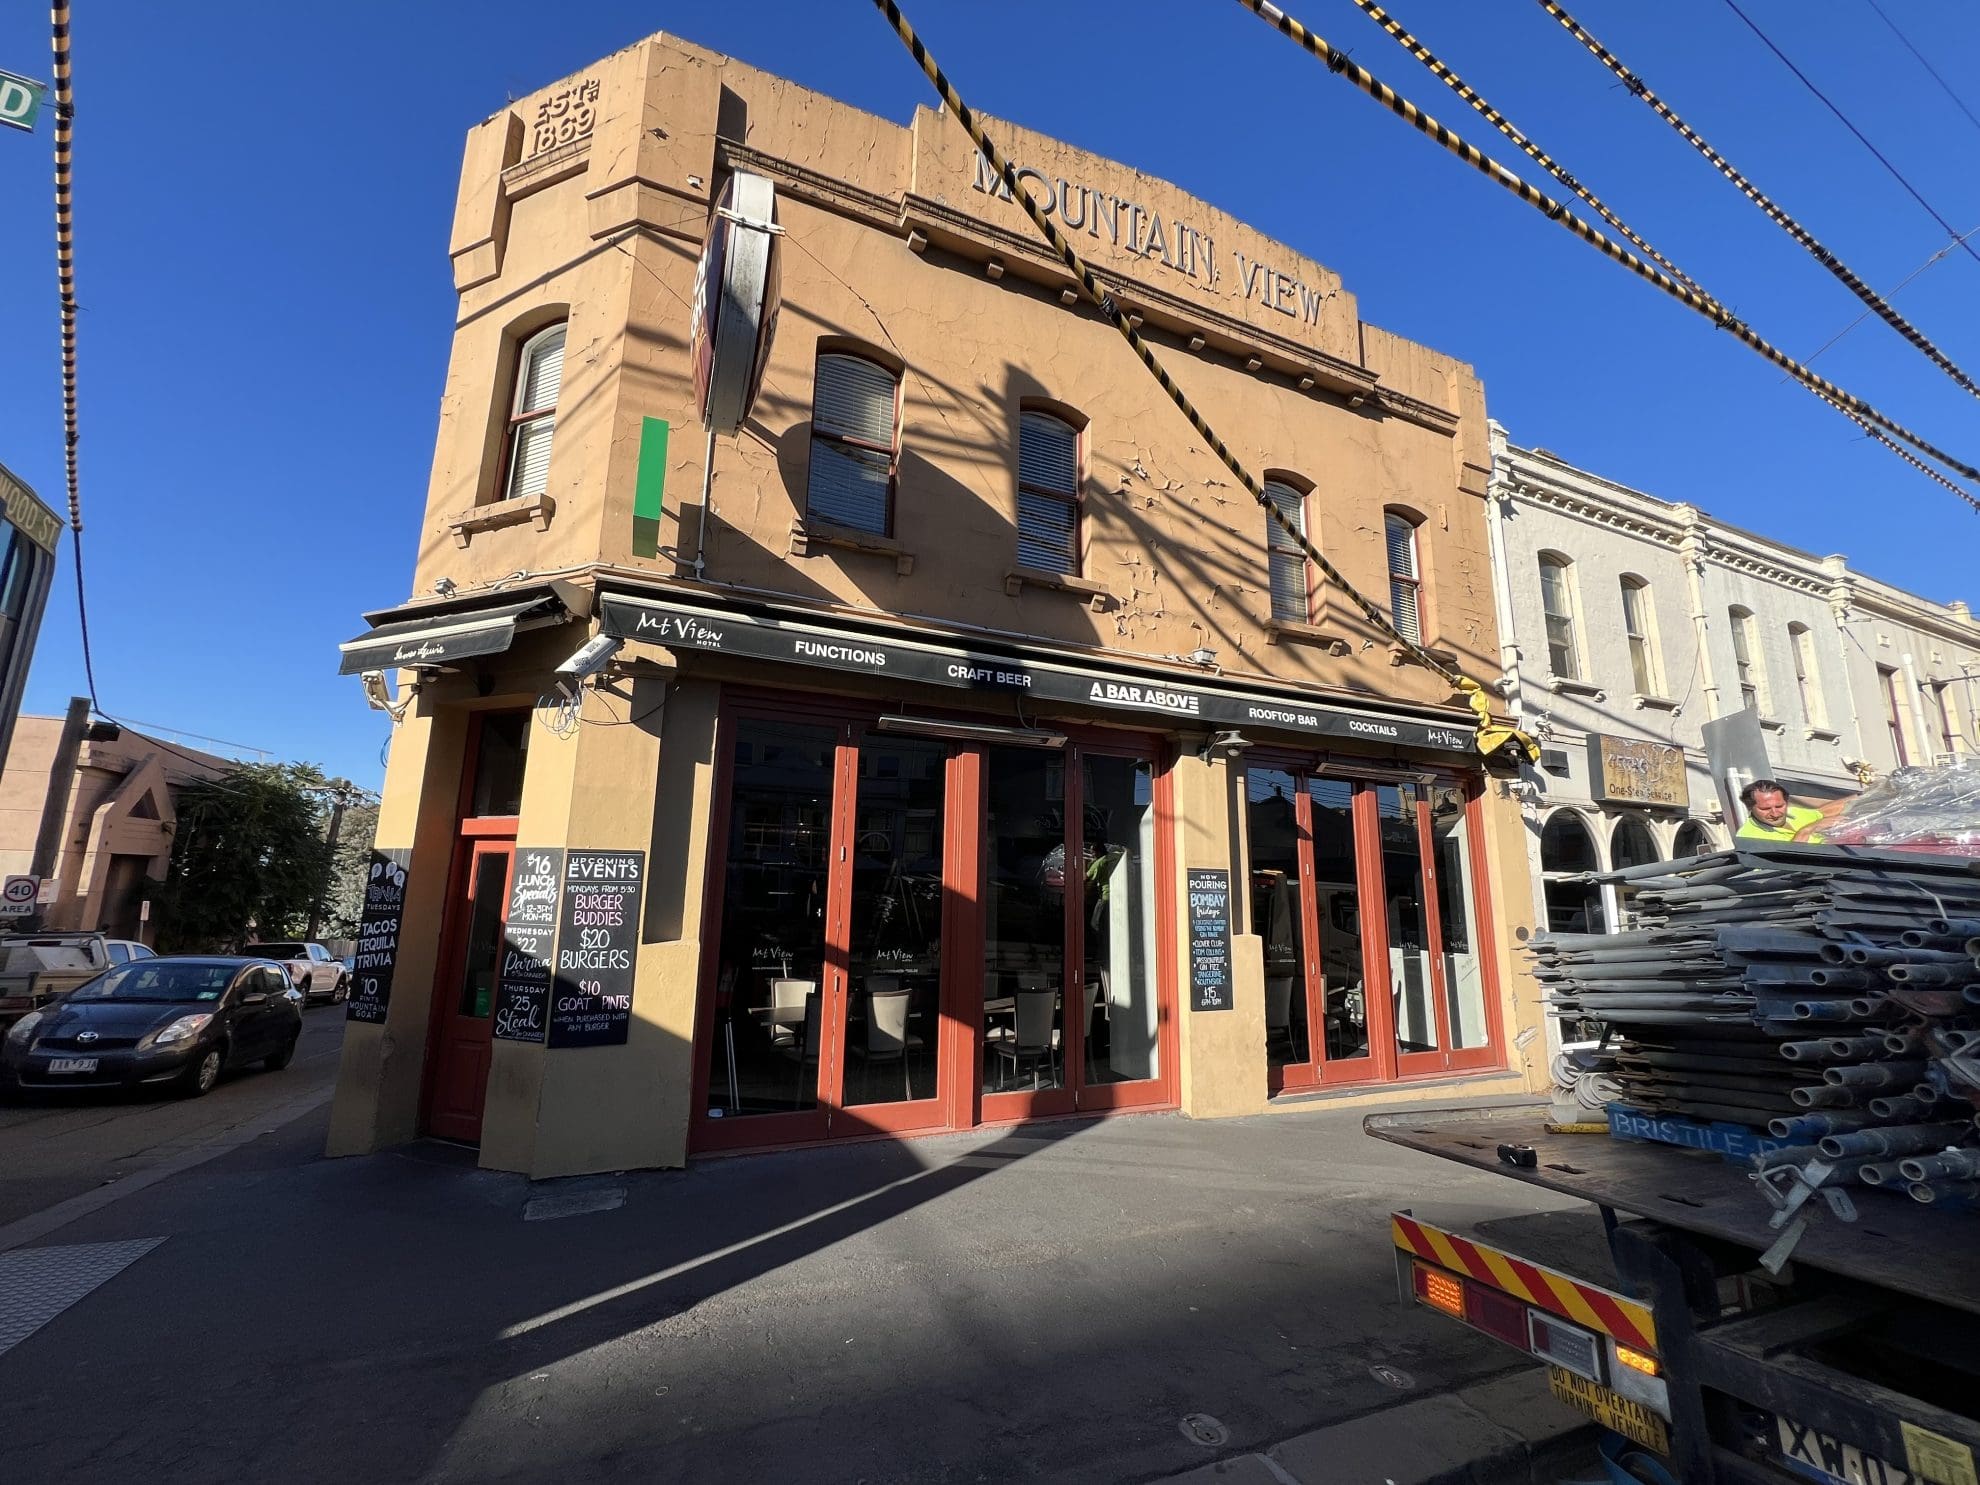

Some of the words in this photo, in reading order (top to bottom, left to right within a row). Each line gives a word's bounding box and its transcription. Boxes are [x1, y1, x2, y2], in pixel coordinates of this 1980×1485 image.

[527, 108, 596, 158] 1869
[972, 147, 1216, 285] MOUNTAIN
[1233, 249, 1323, 326] VIEW
[39, 515, 59, 548] ST
[636, 611, 672, 636] Mt
[674, 618, 723, 641] View
[696, 639, 721, 648] HOTEL
[795, 640, 886, 666] FUNCTIONS
[948, 664, 993, 683] CRAFT
[996, 671, 1032, 688] BEER
[1090, 682, 1103, 697] A
[1106, 684, 1141, 702] BAR
[1144, 689, 1199, 710] ABOVE
[1249, 707, 1296, 723] ROOFTOP
[1297, 715, 1318, 727] BAR
[1349, 720, 1398, 737] COCKTAILS
[1442, 730, 1463, 745] View
[527, 853, 552, 875] $16
[572, 857, 635, 865] UPCOMING
[568, 863, 638, 878] EVENTS
[518, 874, 556, 887] LUNCH
[1190, 879, 1227, 890] POURING
[8, 885, 32, 896] 40
[567, 885, 599, 894] MONDAYS
[602, 885, 618, 894] FROM
[367, 903, 401, 911] TUESDAYS
[575, 893, 624, 910] BURGER
[1190, 893, 1226, 907] BOMBAY
[1, 905, 32, 913] AREA
[521, 912, 553, 922] MON-FRI
[573, 910, 623, 926] BUDDIES
[362, 918, 398, 937] TACOS
[506, 927, 554, 936] WEDNESDAY
[359, 935, 396, 953] TEQUILA
[517, 937, 537, 953] $22
[580, 926, 610, 949] $20
[357, 952, 392, 969] TRIVIA
[503, 951, 552, 977] Parma
[560, 949, 630, 969] BURGERS
[1209, 963, 1220, 971] FIZZ
[503, 984, 546, 994] THURSDAY
[578, 979, 601, 996] $10
[349, 1001, 386, 1012] MOUNTAIN
[359, 995, 379, 1003] PINTS
[511, 995, 531, 1012] $25
[558, 997, 593, 1011] GOAT
[602, 995, 630, 1010] PINTS
[355, 1010, 377, 1018] GOAT
[496, 1005, 541, 1035] Steak
[553, 1015, 574, 1023] WHEN
[576, 1013, 611, 1023] PURCHASED
[612, 1012, 627, 1020] WITH
[585, 1022, 610, 1032] BURGER
[1614, 1113, 1748, 1157] BRISTILE
[1551, 1364, 1566, 1384] DO
[1570, 1371, 1590, 1397] NOT
[1595, 1385, 1660, 1431] OVERTAKE
[1554, 1384, 1603, 1421] TURNING
[1609, 1411, 1661, 1448] VEHICLE
